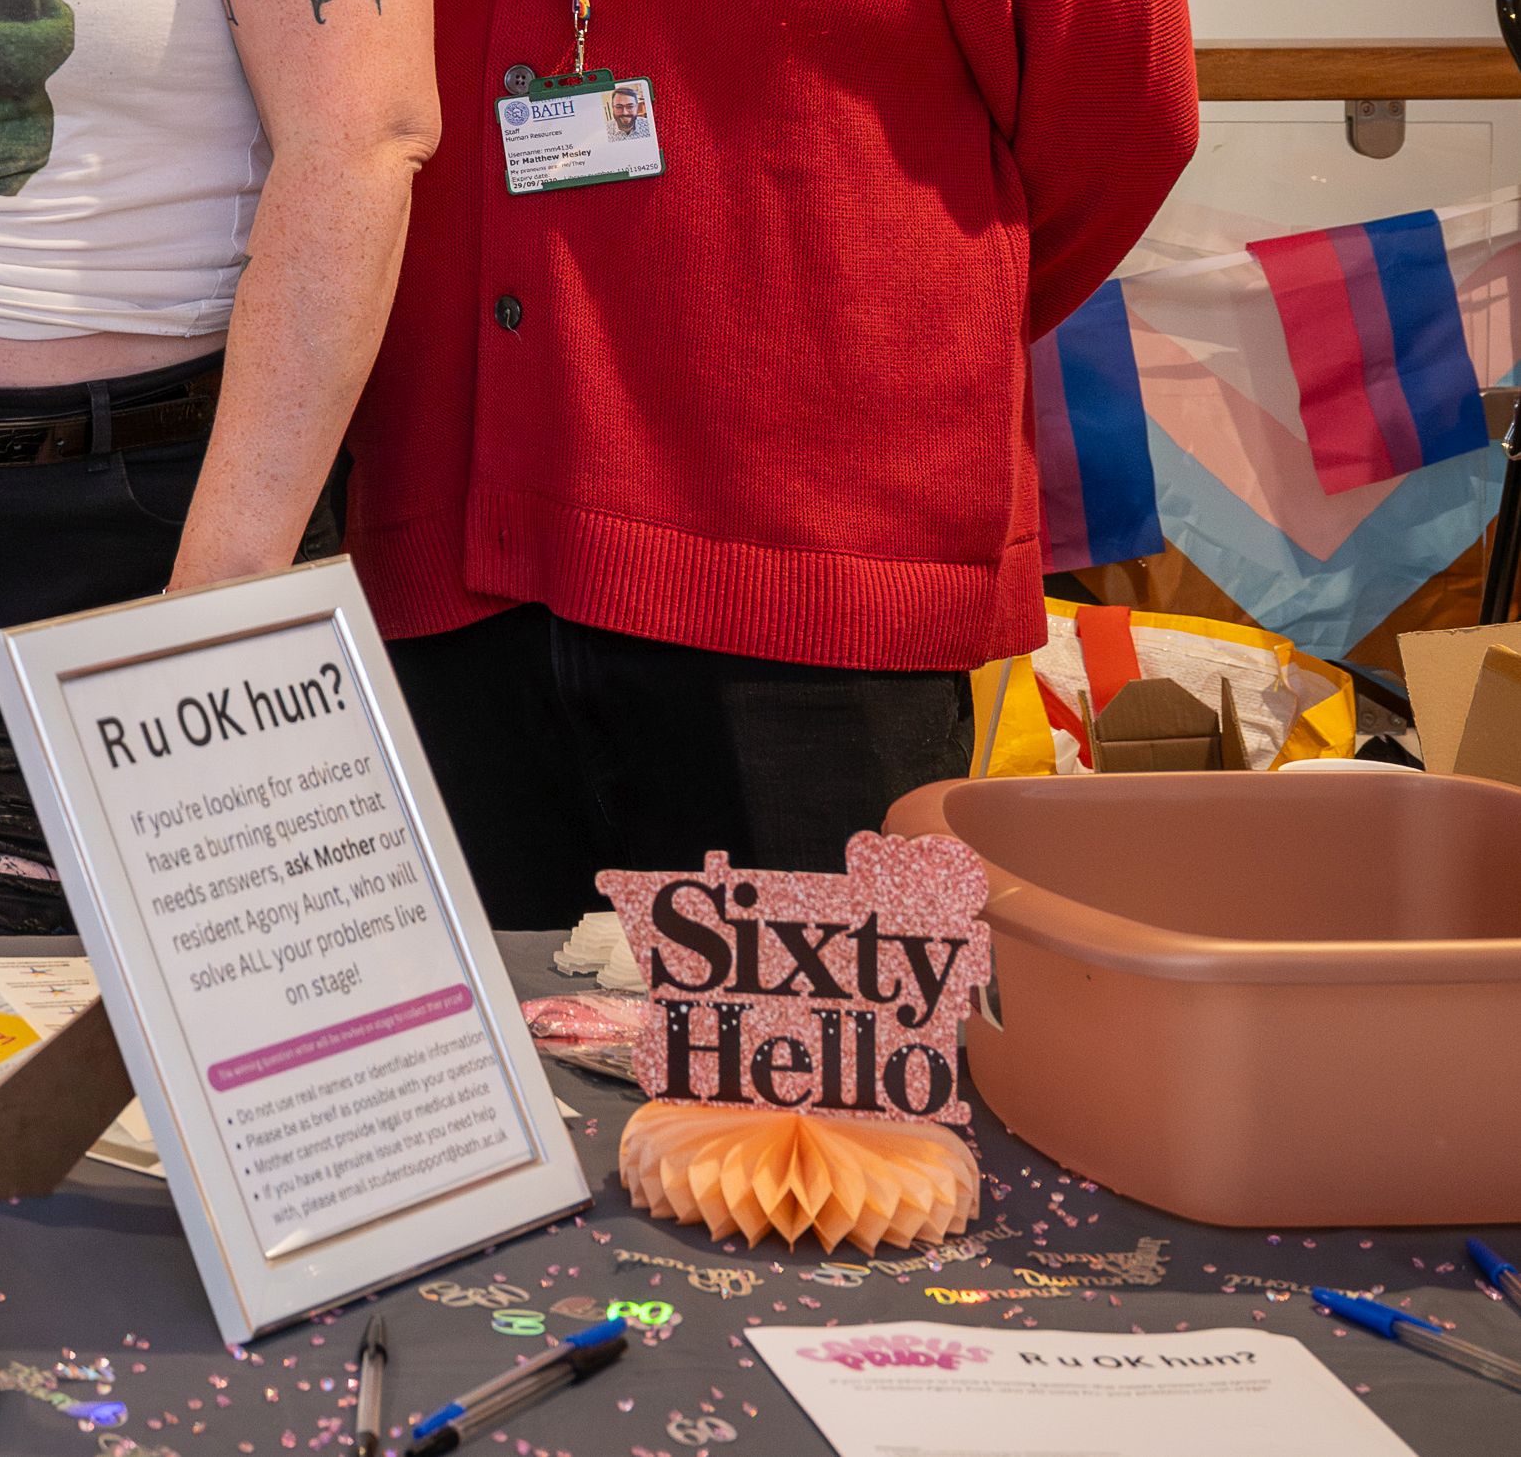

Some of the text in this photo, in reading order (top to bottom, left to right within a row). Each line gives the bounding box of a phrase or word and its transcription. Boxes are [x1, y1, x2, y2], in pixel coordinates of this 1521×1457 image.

[505, 130, 563, 143] Human Resources
[531, 100, 575, 119] BATH
[509, 159, 520, 167] Dr
[522, 153, 560, 165] Matthew
[96, 661, 348, 769] R u OK hun?
[130, 756, 372, 839] If you're looking for advice or
[146, 791, 387, 875] have a burning question that
[152, 826, 408, 917] needs answers, ask Mother our
[172, 860, 419, 955] resident Agony Aunt, who will
[189, 903, 428, 993] solve ALL your problems live
[284, 961, 364, 1007] on stage!
[650, 878, 971, 1030] Sixty
[654, 997, 954, 1117] Hello
[1018, 1350, 1259, 1370] R u OK hun?
